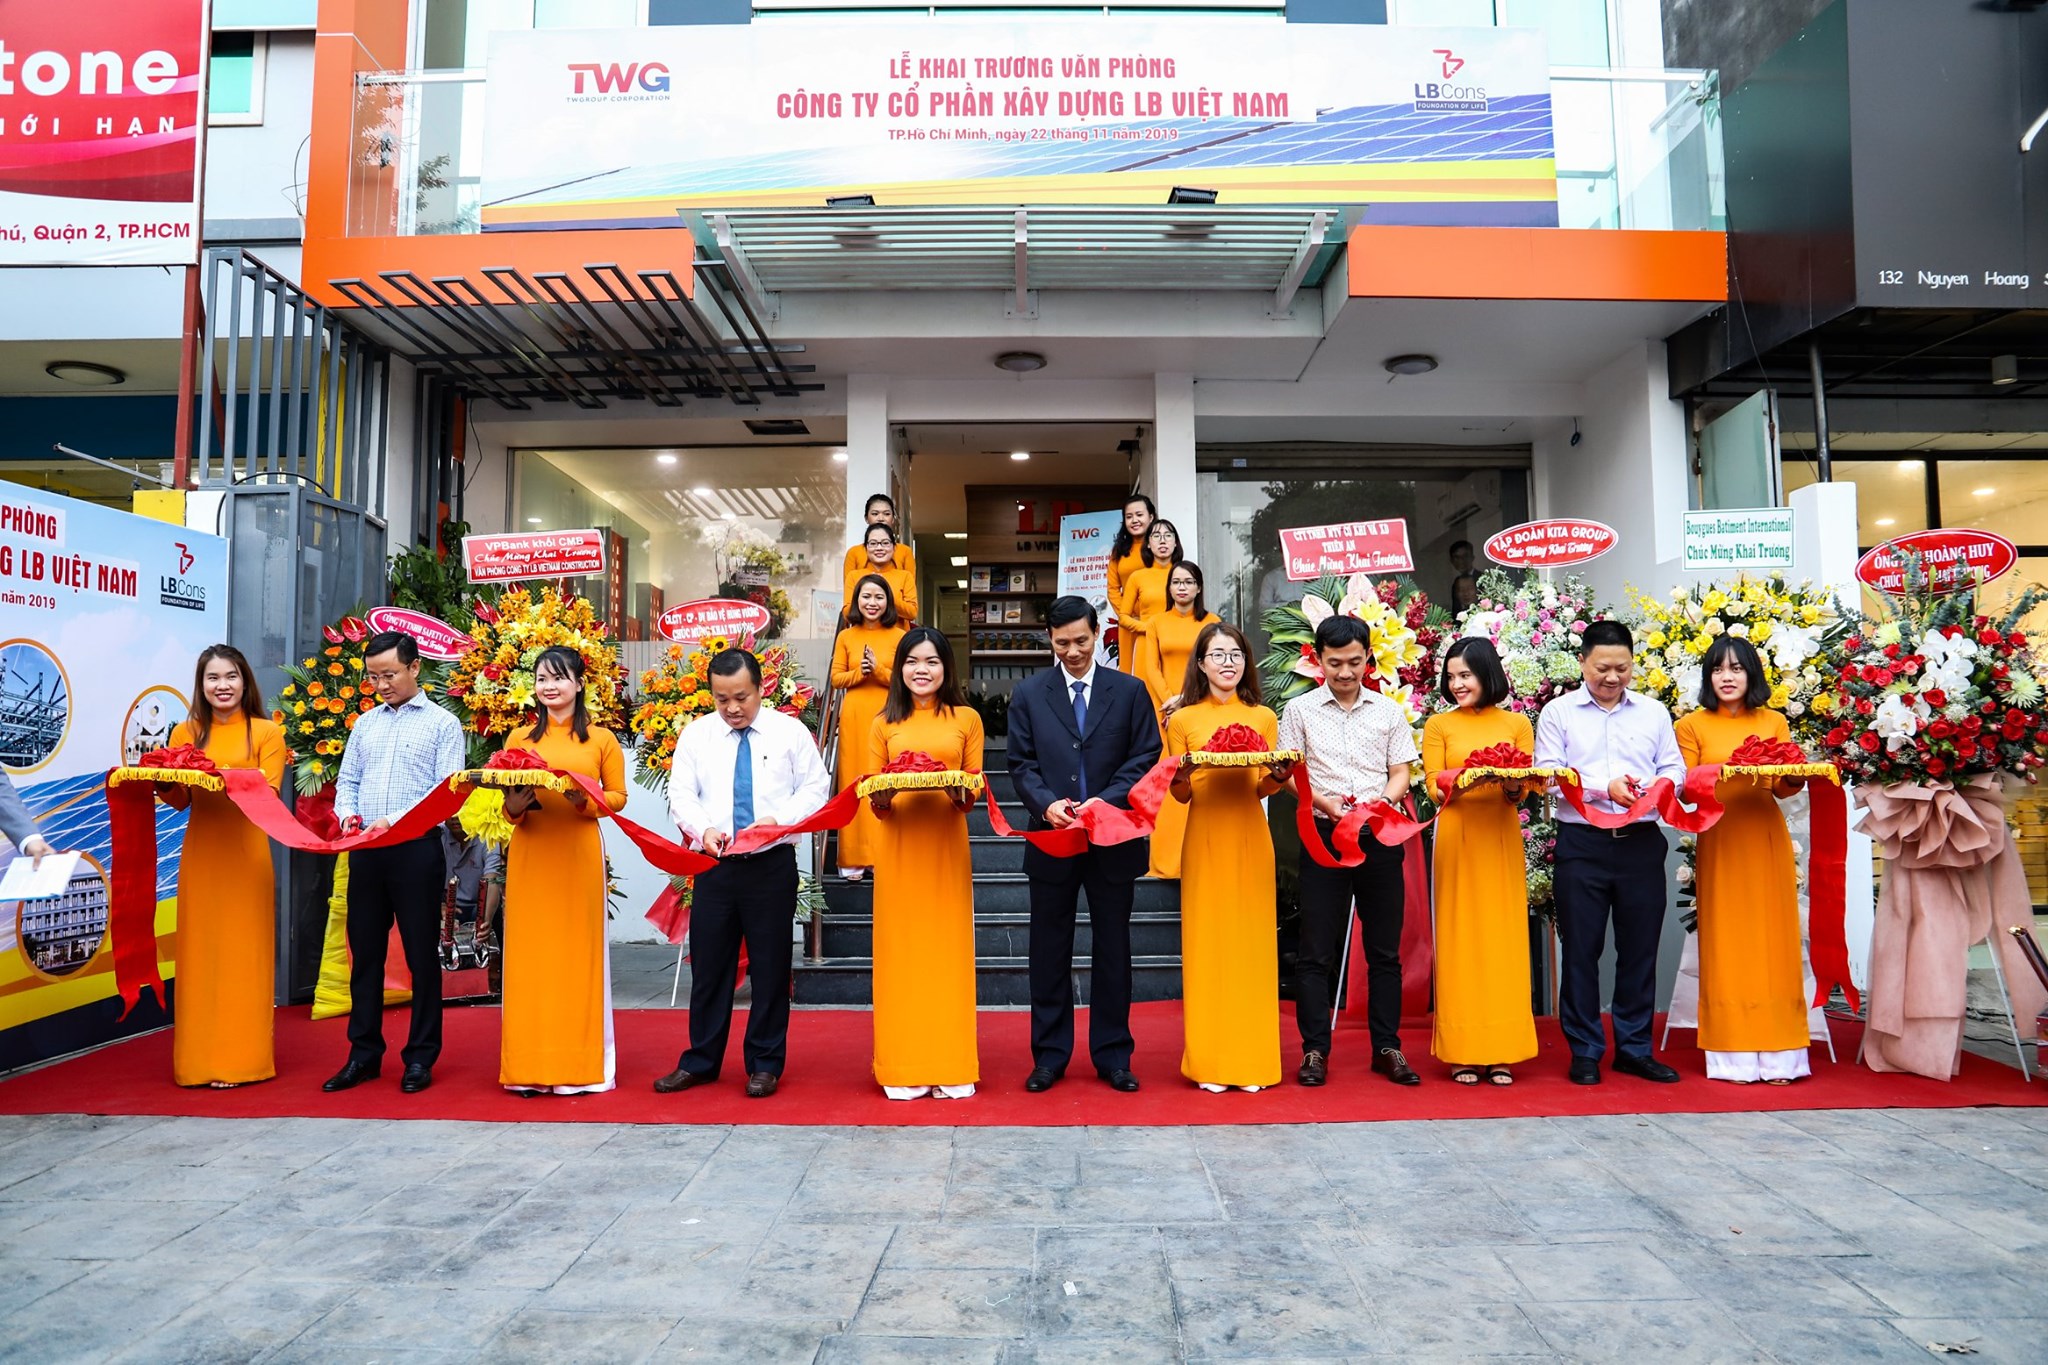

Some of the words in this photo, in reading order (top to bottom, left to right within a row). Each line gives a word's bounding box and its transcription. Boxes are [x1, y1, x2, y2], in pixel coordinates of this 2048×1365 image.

[890, 51, 911, 79] LỄ
[919, 58, 966, 79] KHAI
[974, 56, 1053, 79] TRƯƠNG
[1061, 54, 1100, 78] VĂN
[1109, 53, 1176, 78] PHÒNG
[567, 62, 671, 94] TWG
[777, 88, 842, 118] CÔNG
[852, 92, 879, 117] TY
[888, 81, 920, 117] CỔ
[930, 82, 993, 117] PHẦN
[1004, 86, 1049, 116] XÂY
[1058, 89, 1124, 121] DỰNG
[1135, 91, 1162, 116] LB
[1172, 87, 1223, 122] VIỆT
[1233, 92, 1289, 117] NAM
[1414, 83, 1487, 99] LBCons
[96, 117, 175, 138] HẠN
[929, 128, 951, 140] Chí
[955, 128, 991, 141] Minh,
[995, 128, 1026, 142] ngày
[1031, 129, 1047, 139] 22
[1051, 128, 1088, 141] tháng
[1093, 129, 1107, 139] 11
[1112, 127, 1141, 139] năm
[1145, 129, 1178, 139] 2019
[33, 224, 87, 244] Quận
[94, 224, 111, 242] 2,
[118, 223, 190, 239] TP.HCM
[1879, 270, 1904, 285] 132
[1918, 270, 1969, 289] Nguyen
[1985, 271, 2029, 289] Hoang
[1, 504, 57, 540] PHÒNG
[1686, 520, 1716, 538] Bouygues
[1747, 517, 1791, 533] International
[485, 540, 530, 551] VPBank
[558, 536, 584, 547] CMB
[1071, 527, 1099, 539] TWG
[1492, 536, 1513, 552] TẬP
[1514, 527, 1545, 544] ĐOÀN
[1546, 526, 1569, 538] KITA
[1571, 526, 1610, 542] GROUP
[533, 549, 556, 559] Khai
[1687, 544, 1708, 560] Chúc
[1735, 543, 1756, 559] Khai
[1925, 545, 1966, 564] HOÀNG
[1969, 543, 1995, 559] HUY
[21, 549, 45, 581] LB
[52, 553, 92, 593] VIỆT
[98, 564, 137, 597] NAM
[1880, 571, 1902, 588] CHÚC
[161, 575, 206, 599] LBCons
[1, 590, 25, 605] năm
[29, 594, 56, 609] 2019
